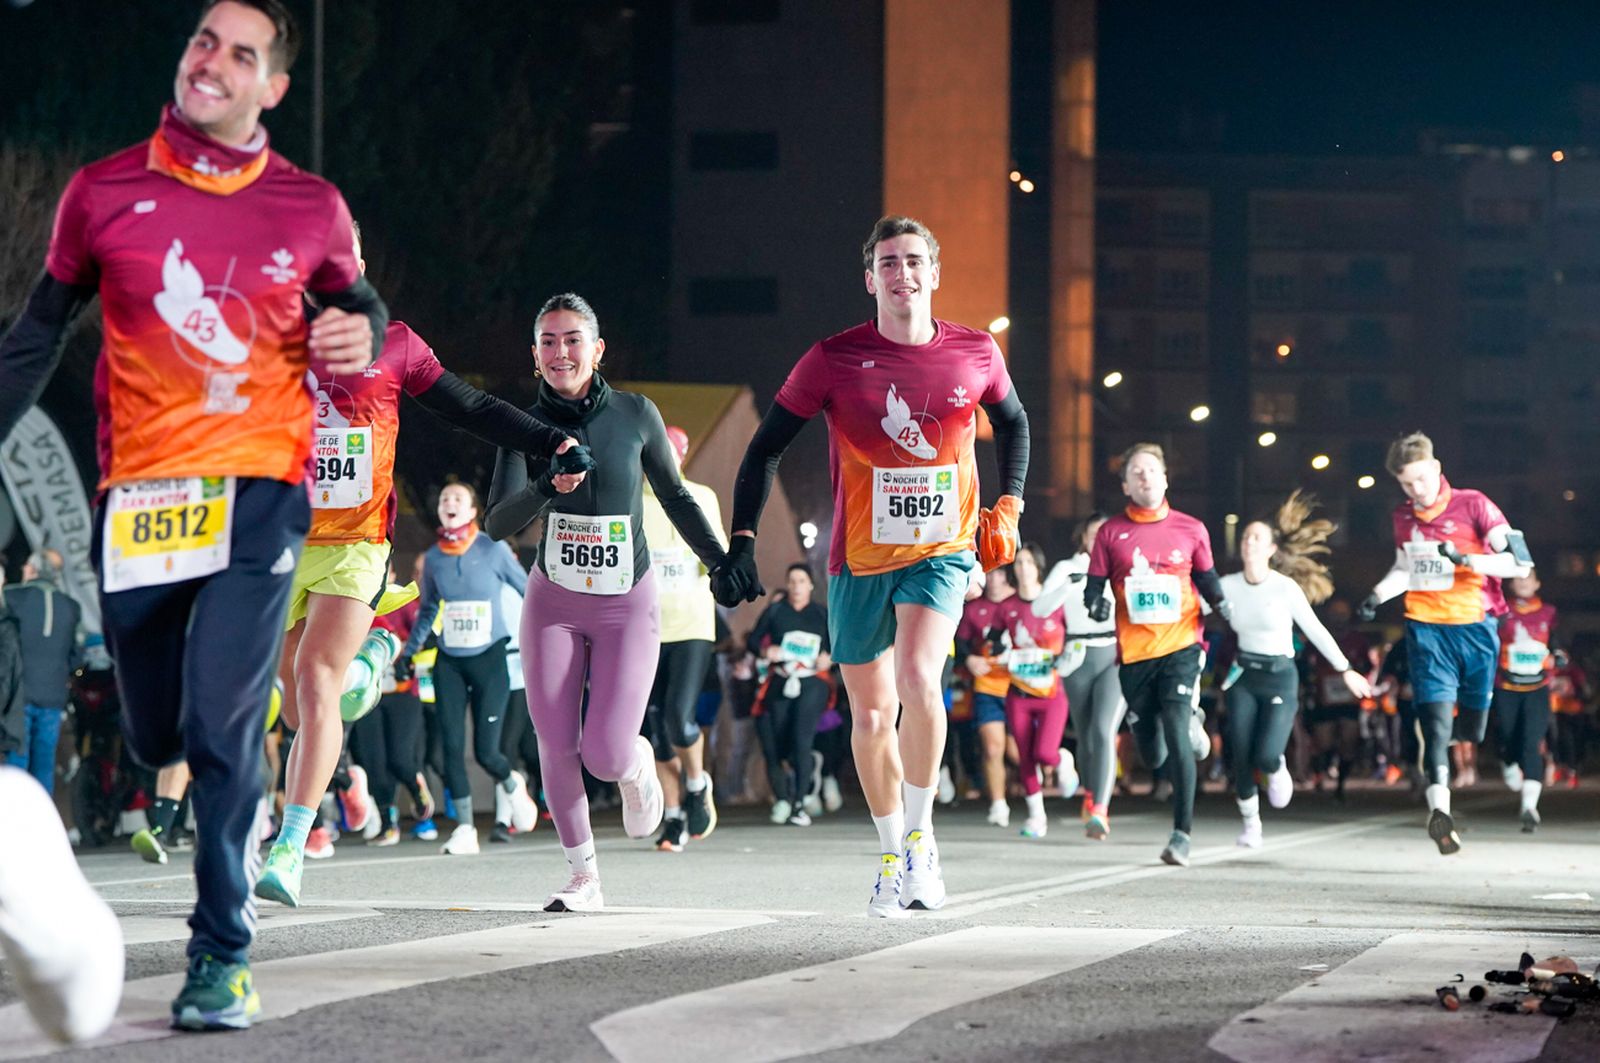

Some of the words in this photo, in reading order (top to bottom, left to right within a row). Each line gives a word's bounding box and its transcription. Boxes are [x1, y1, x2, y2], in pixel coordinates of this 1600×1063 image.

[183, 309, 218, 342] 43
[318, 402, 330, 418] 3
[897, 426, 919, 447] 43
[315, 445, 339, 456] NTÓN
[315, 457, 356, 481] 694
[893, 476, 918, 484] NOCHE
[920, 476, 928, 484] DE
[882, 485, 900, 493] SAN
[901, 484, 929, 494] ANTÓN
[889, 494, 944, 518] 5692
[133, 505, 209, 544] 8512
[567, 523, 590, 532] NOCHE
[592, 525, 602, 533] DE
[556, 532, 574, 541] SAN
[574, 533, 602, 543] ANTÓN
[561, 543, 619, 567] 5693
[1414, 560, 1442, 574] 2579
[1138, 592, 1169, 606] 8310
[452, 618, 479, 631] 7301
